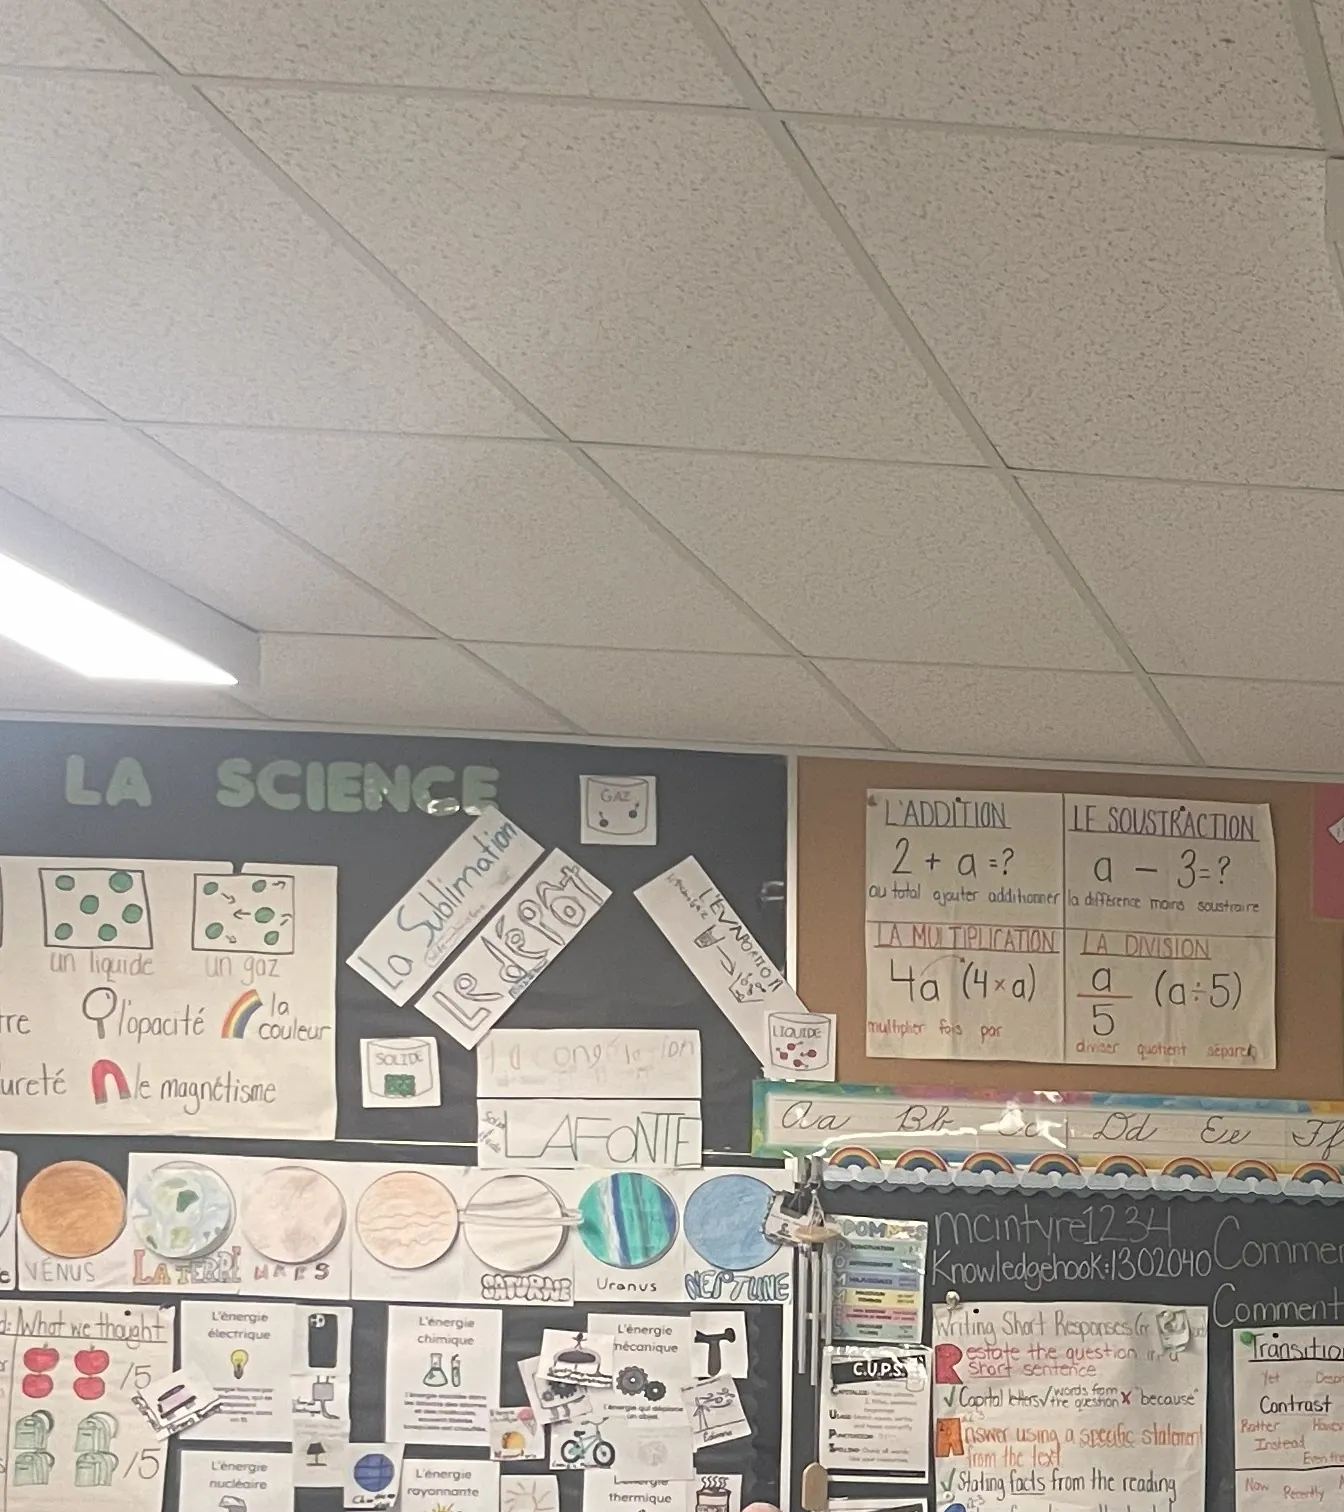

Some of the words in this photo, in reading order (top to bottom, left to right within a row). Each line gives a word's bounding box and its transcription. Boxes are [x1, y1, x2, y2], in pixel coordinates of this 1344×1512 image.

[64, 754, 152, 807] LA
[215, 757, 500, 815] SCIENCE
[885, 800, 1008, 829] L'ADDITION
[1107, 806, 1256, 842] SOUSTRACTION
[891, 883, 921, 898] total
[933, 888, 980, 904] ajouter
[988, 888, 1060, 904] additionner
[357, 953, 415, 991] La
[397, 821, 518, 948] Sublimation
[1197, 899, 1261, 914] soustraire
[911, 924, 1058, 953] MULTIPLICATION
[1124, 935, 1212, 959] DIVISION
[50, 953, 76, 973] un
[90, 951, 155, 982] liquide
[243, 955, 280, 986] gaz
[270, 993, 289, 1016] la
[118, 1000, 206, 1043] l'opacité
[259, 1017, 331, 1041] couleur
[772, 1024, 823, 1041] LIQUIDE
[375, 1051, 424, 1066] SOLIDE
[161, 1070, 277, 1115] magnétisme
[1092, 1111, 1159, 1142] Dd
[935, 1204, 1172, 1250] mcintyre1234
[27, 1257, 96, 1283] VÉNUS
[132, 1249, 170, 1286] LA
[481, 1273, 572, 1302] SATURNE
[597, 1276, 657, 1293] Uranus
[685, 1271, 792, 1301] NEPTUNE
[16, 1306, 63, 1338] What
[71, 1320, 91, 1338] we
[100, 1312, 166, 1350] thought
[211, 1311, 269, 1326] L'énergie
[418, 1315, 476, 1332] L'énergie
[1002, 1309, 1046, 1337] Short
[1055, 1310, 1133, 1345] Responses
[208, 1329, 271, 1343] électrique
[417, 1333, 475, 1348] chimique
[617, 1323, 674, 1340] L'énergie
[1066, 1345, 1138, 1367] question
[1023, 1362, 1097, 1377] sentence
[959, 1386, 1004, 1408] Capital
[1259, 1394, 1333, 1416] Contrast
[1016, 1424, 1060, 1448] using
[1254, 1434, 1306, 1452] Instead
[211, 1460, 268, 1475] L'énergie
[415, 1467, 473, 1483] L'énergie
[209, 1477, 268, 1491] nucléaire
[957, 1469, 1006, 1501] Stating
[1051, 1469, 1086, 1493] from
[1091, 1467, 1115, 1492] the
[1122, 1469, 1178, 1502] reading
